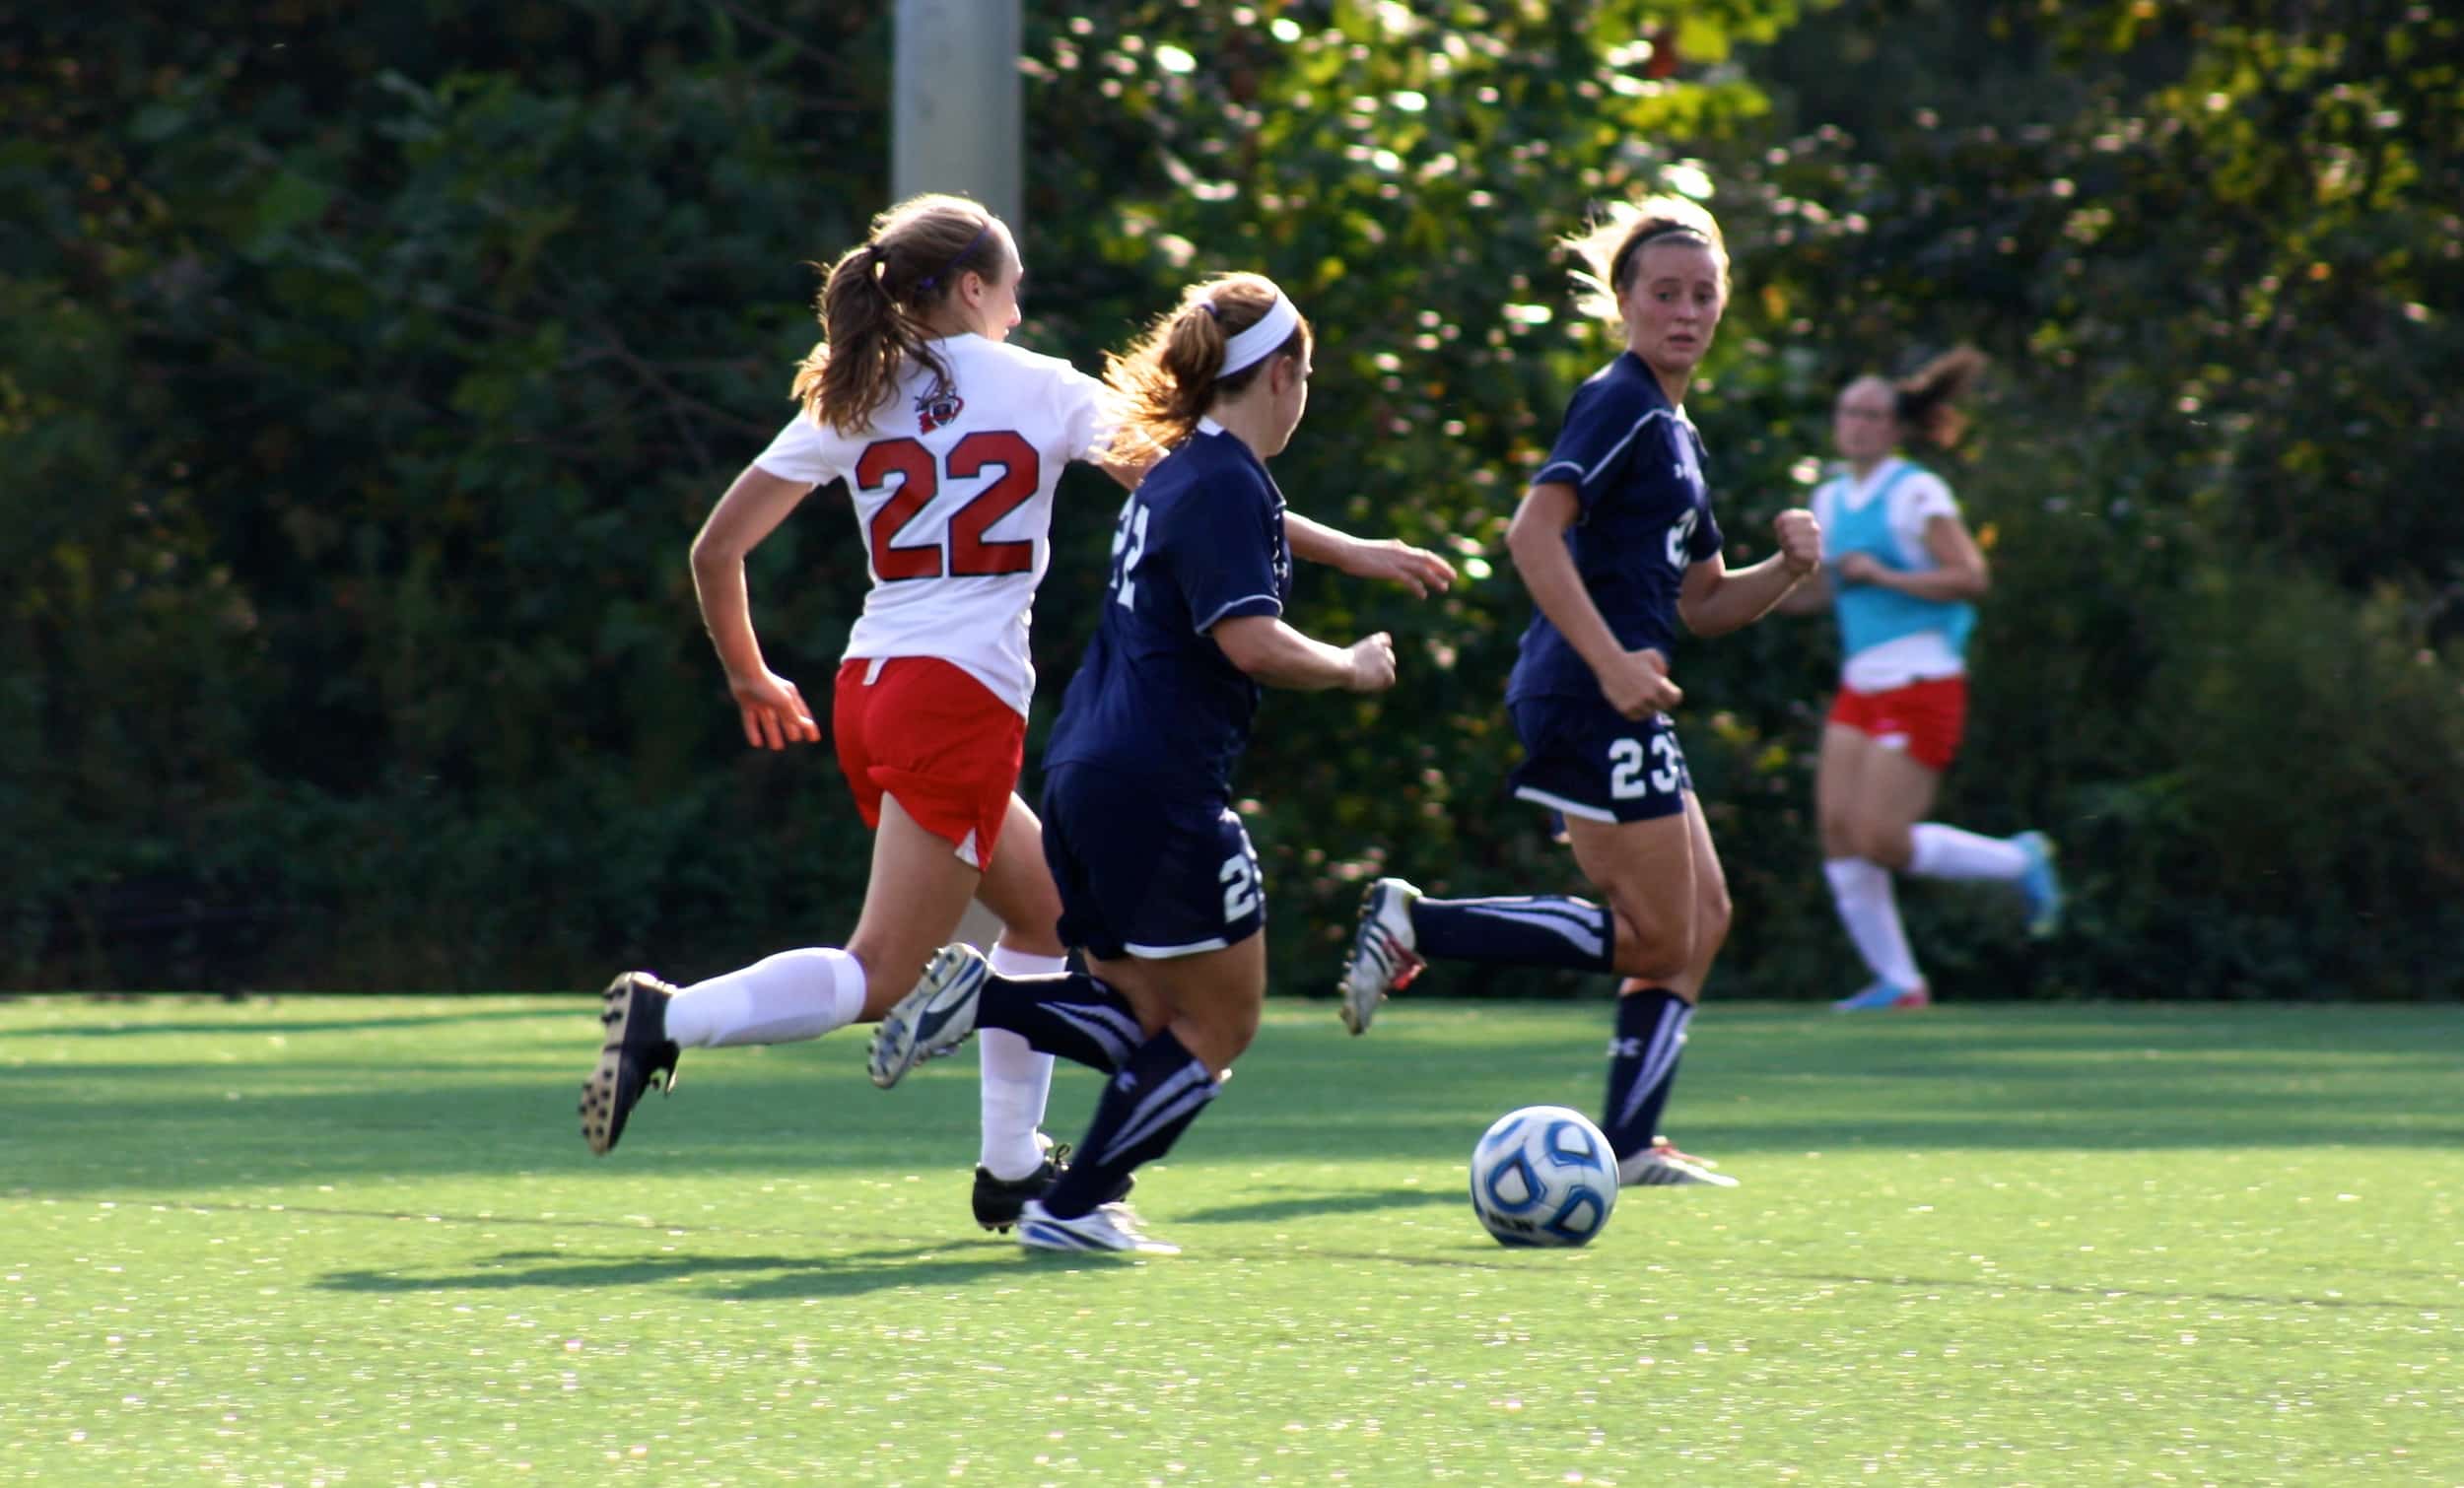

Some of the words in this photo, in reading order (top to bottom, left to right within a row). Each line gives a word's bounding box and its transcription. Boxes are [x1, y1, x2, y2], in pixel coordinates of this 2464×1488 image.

[856, 430, 1040, 582] 22
[1666, 507, 1697, 570] 2
[1608, 733, 1679, 799] 23
[1218, 852, 1266, 923] 2
